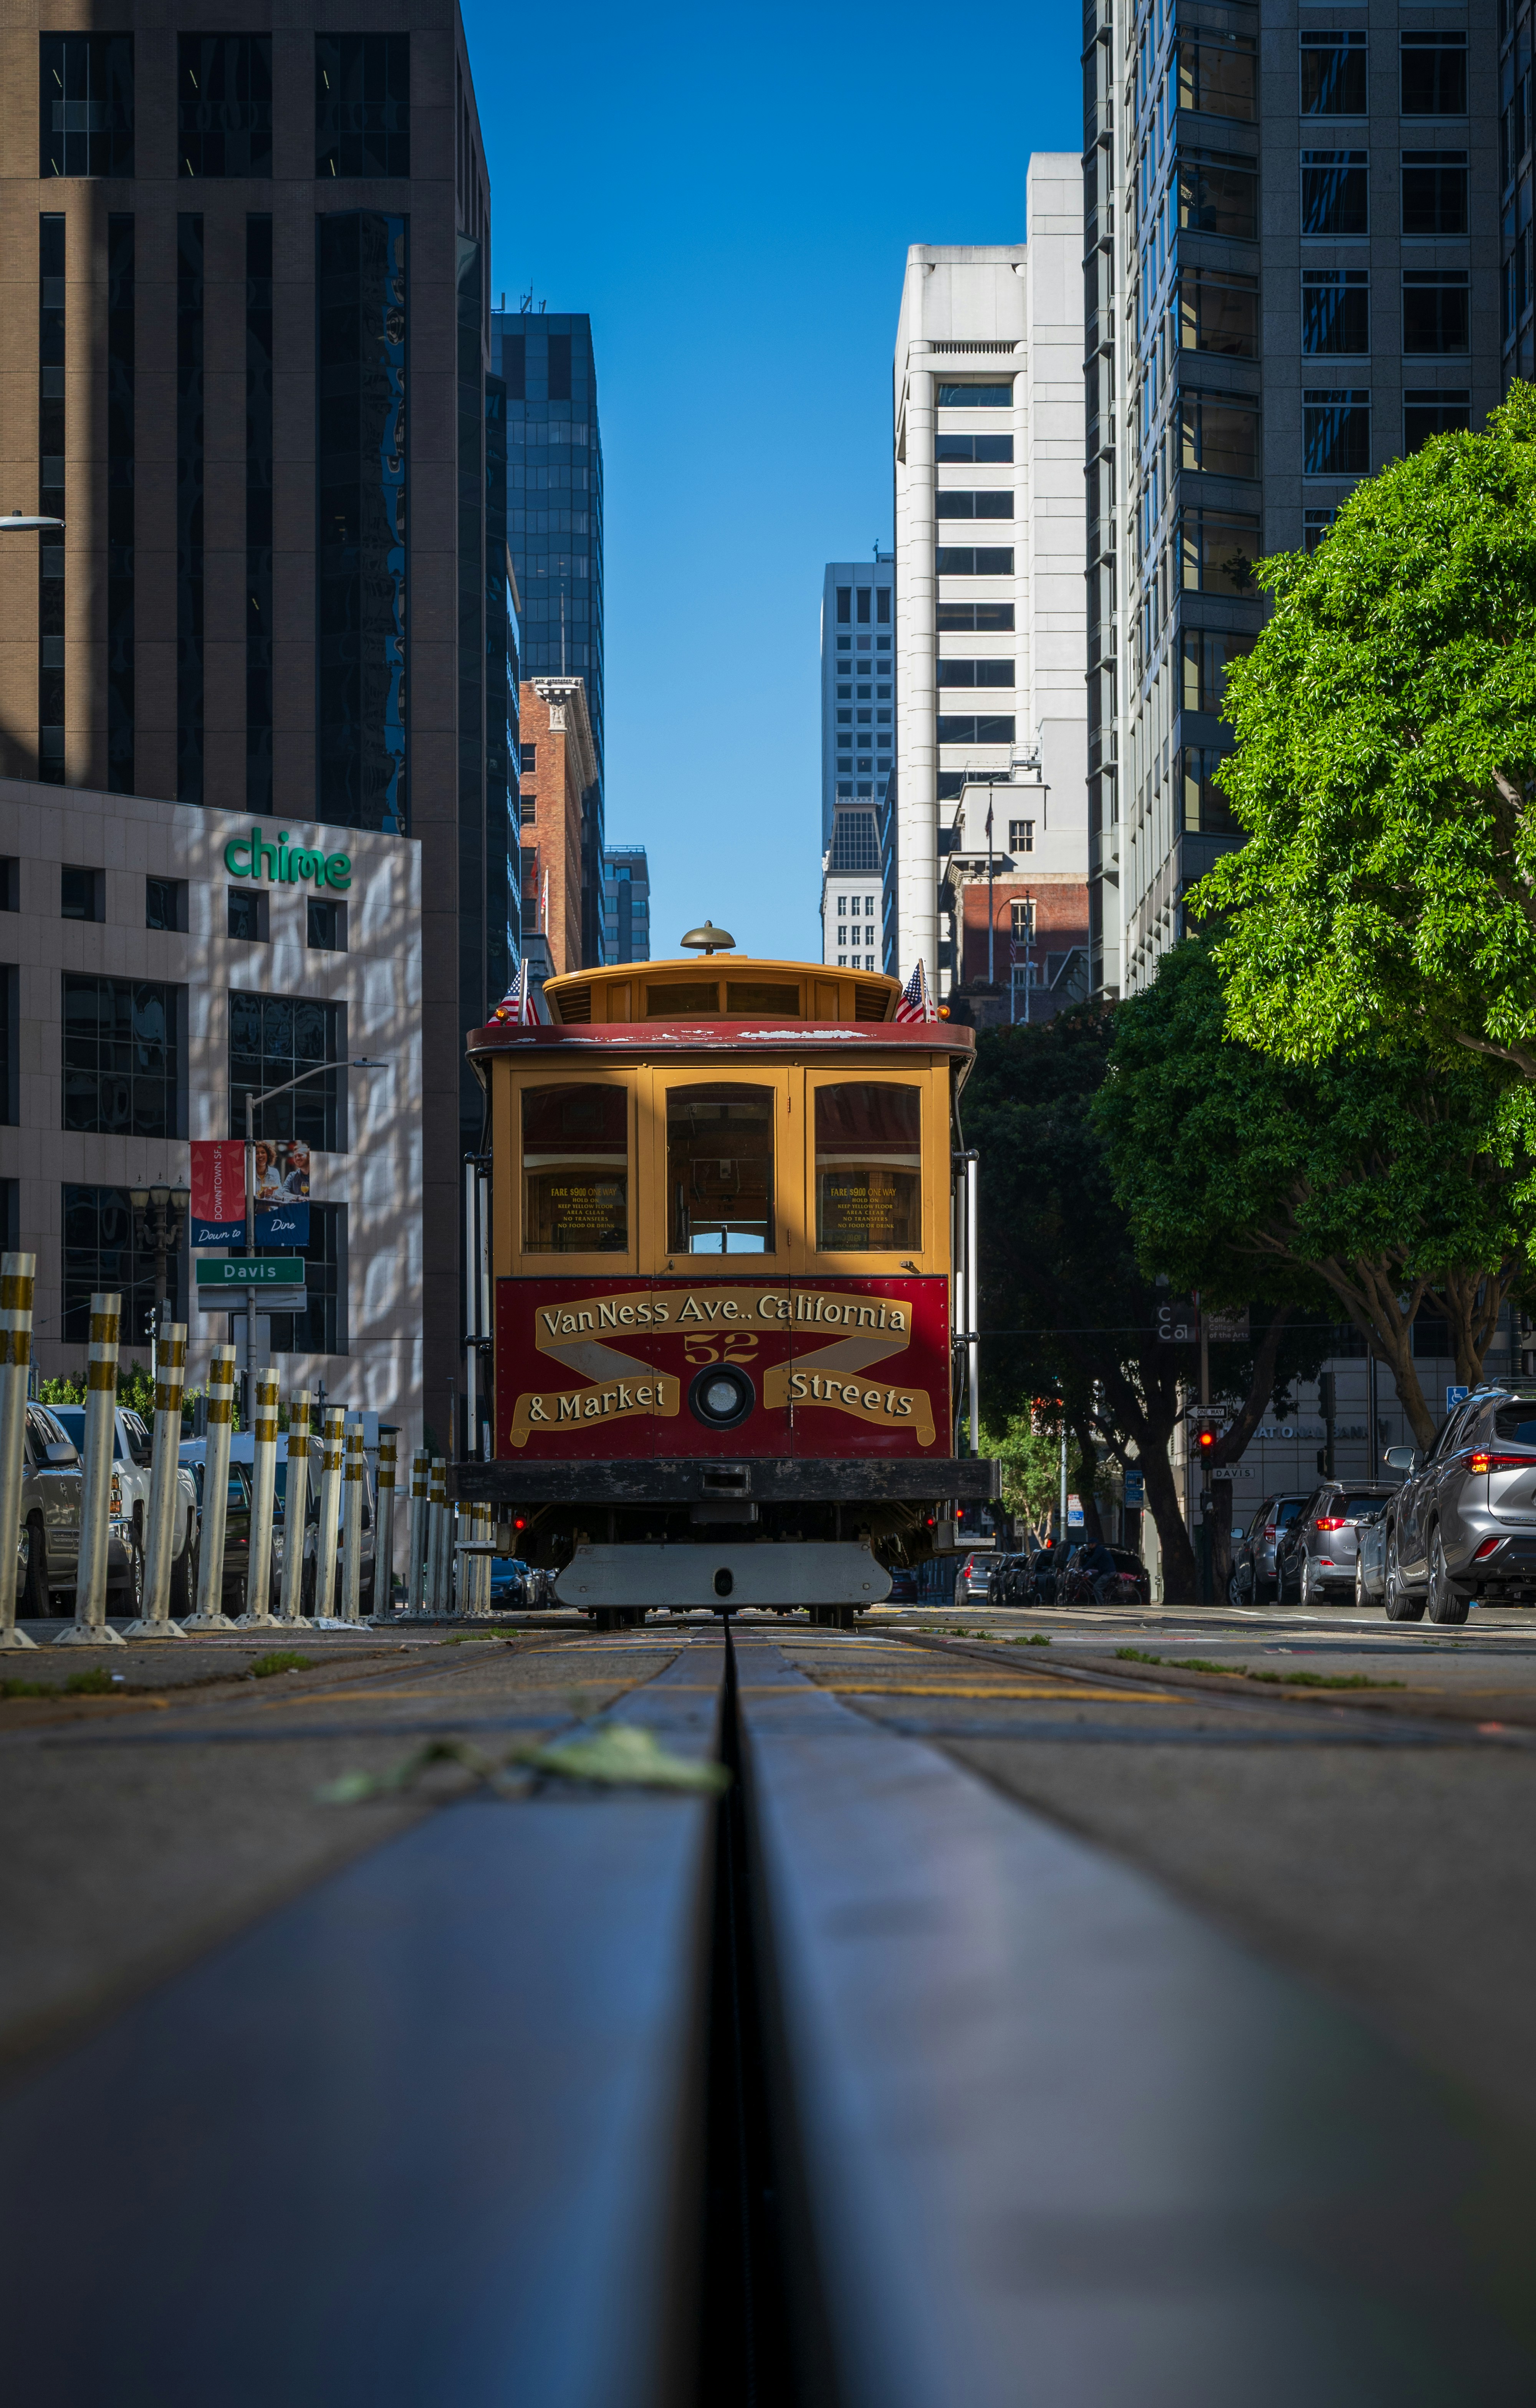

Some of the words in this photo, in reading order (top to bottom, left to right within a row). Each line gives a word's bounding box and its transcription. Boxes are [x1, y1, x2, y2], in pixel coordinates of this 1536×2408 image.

[224, 827, 351, 889] chime
[214, 1149, 222, 1158] SF
[551, 1188, 568, 1196] FARE
[570, 1188, 586, 1196] $9.00
[849, 1188, 866, 1196] $9.00
[270, 1219, 296, 1231] Dine
[198, 1229, 230, 1242] Down
[232, 1228, 241, 1238] to
[224, 1264, 276, 1278] Davis
[543, 1309, 594, 1336] Van
[596, 1301, 670, 1329] Ness
[677, 1295, 752, 1323] Ave.,
[756, 1295, 906, 1331] California
[684, 1332, 759, 1364] 52
[528, 1396, 551, 1422] &
[554, 1382, 665, 1422] Market
[788, 1373, 914, 1417] Streets
